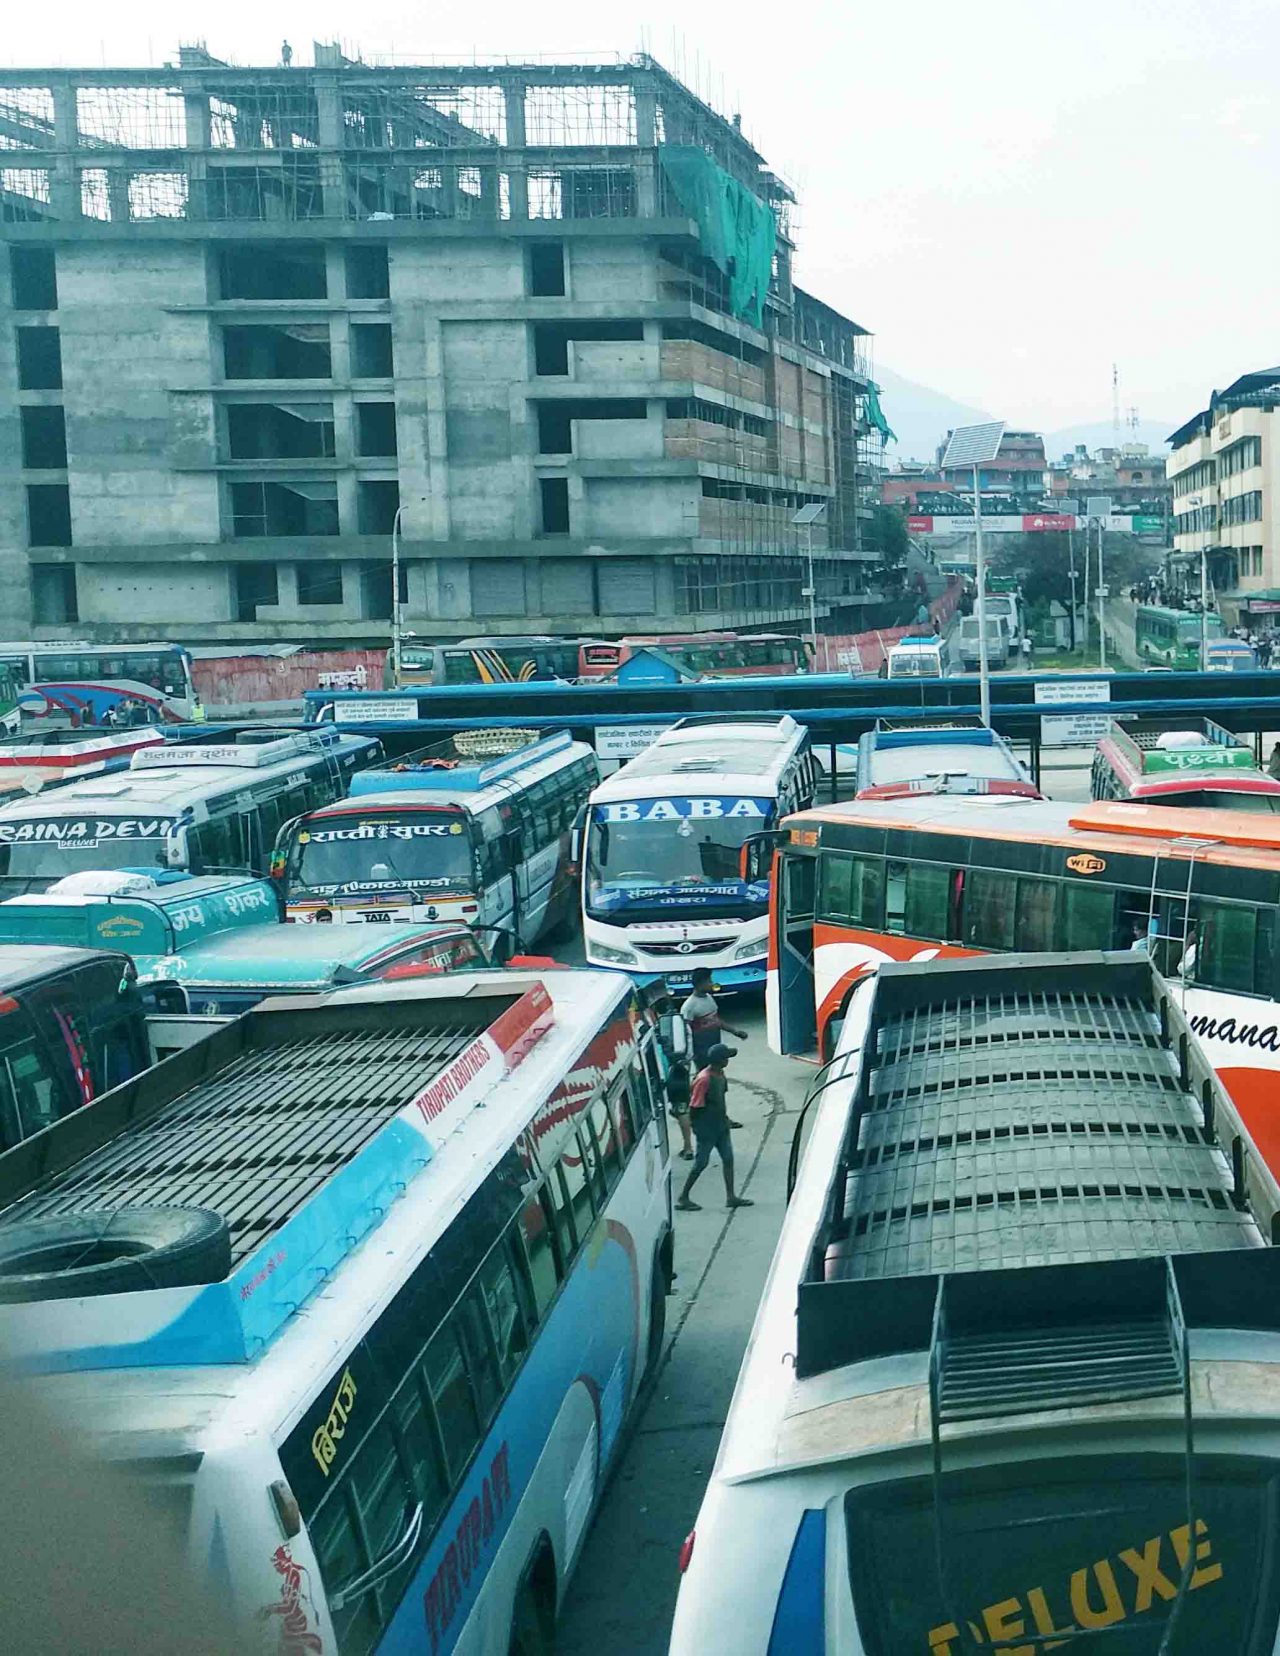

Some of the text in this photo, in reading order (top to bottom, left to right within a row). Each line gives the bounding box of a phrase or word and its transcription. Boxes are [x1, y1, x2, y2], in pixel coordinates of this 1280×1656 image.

[604, 799, 766, 823] BABA
[95, 820, 170, 837] DEVI
[389, 824, 450, 840] सुपर
[60, 839, 95, 847] DELUXE
[364, 913, 391, 922] TATA
[415, 1039, 491, 1125] TIRUPATI BROTHERS
